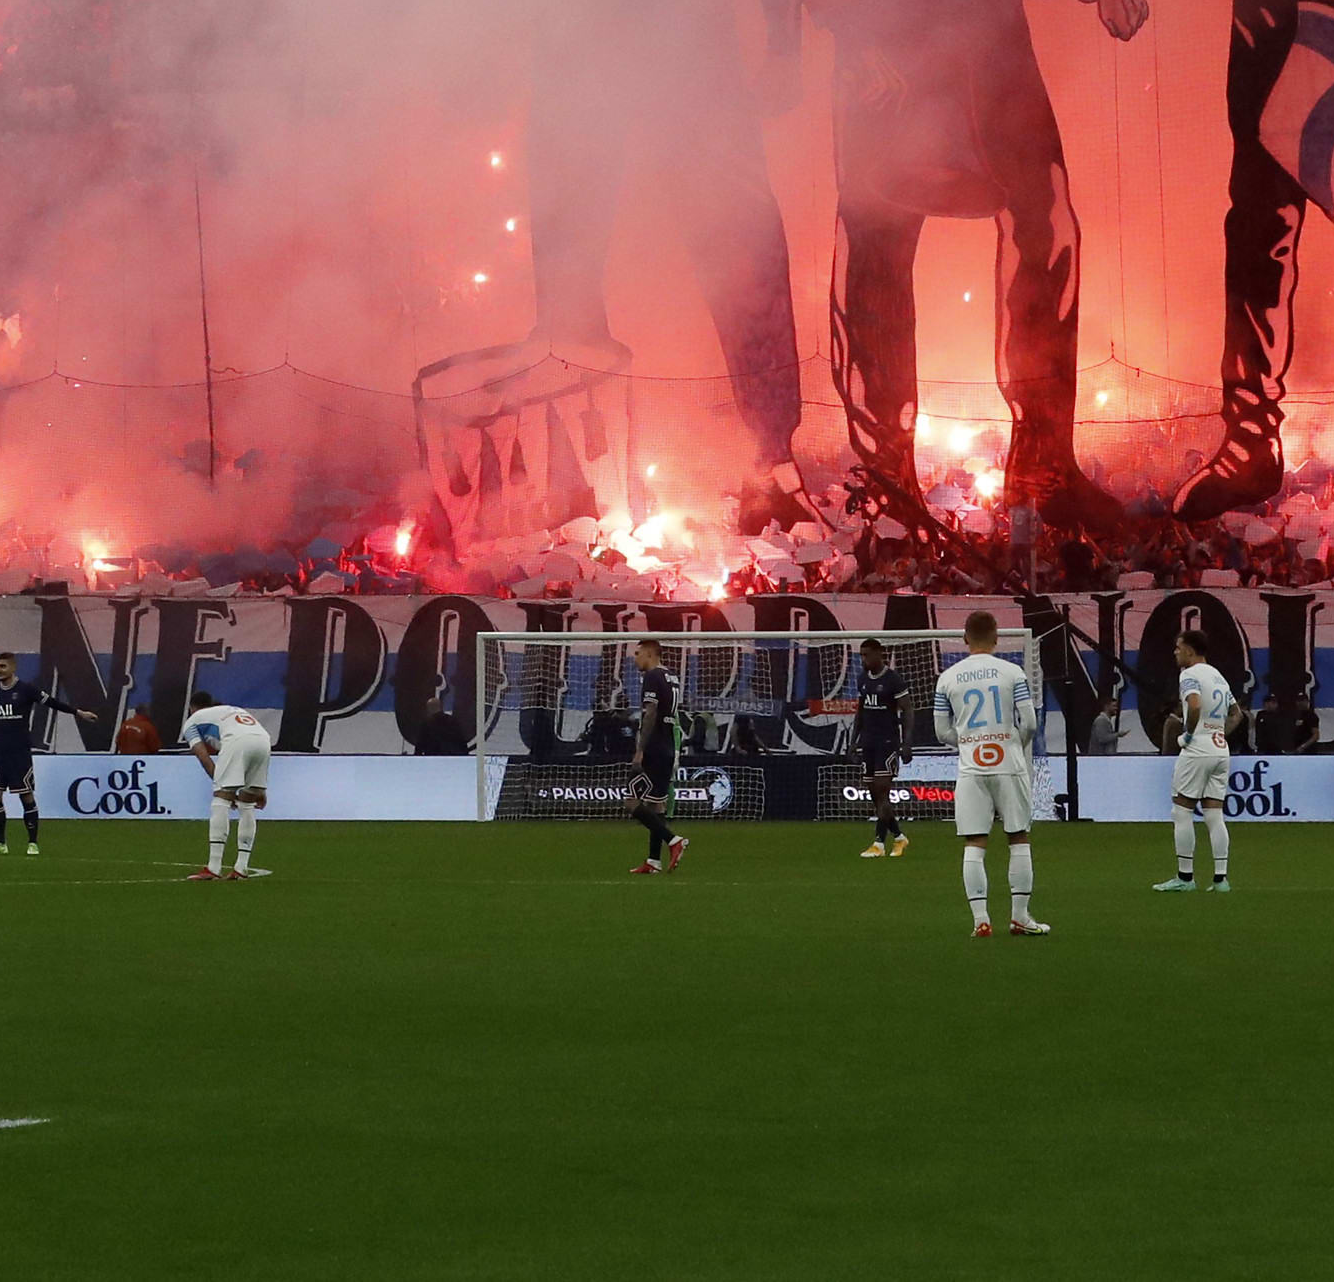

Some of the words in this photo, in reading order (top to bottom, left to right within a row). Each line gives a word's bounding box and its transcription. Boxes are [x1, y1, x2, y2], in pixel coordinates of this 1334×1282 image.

[963, 685, 1002, 729] 21
[107, 759, 146, 791] of
[1228, 760, 1270, 792] of
[67, 776, 172, 815] Cool.
[1207, 781, 1297, 817] ool.
